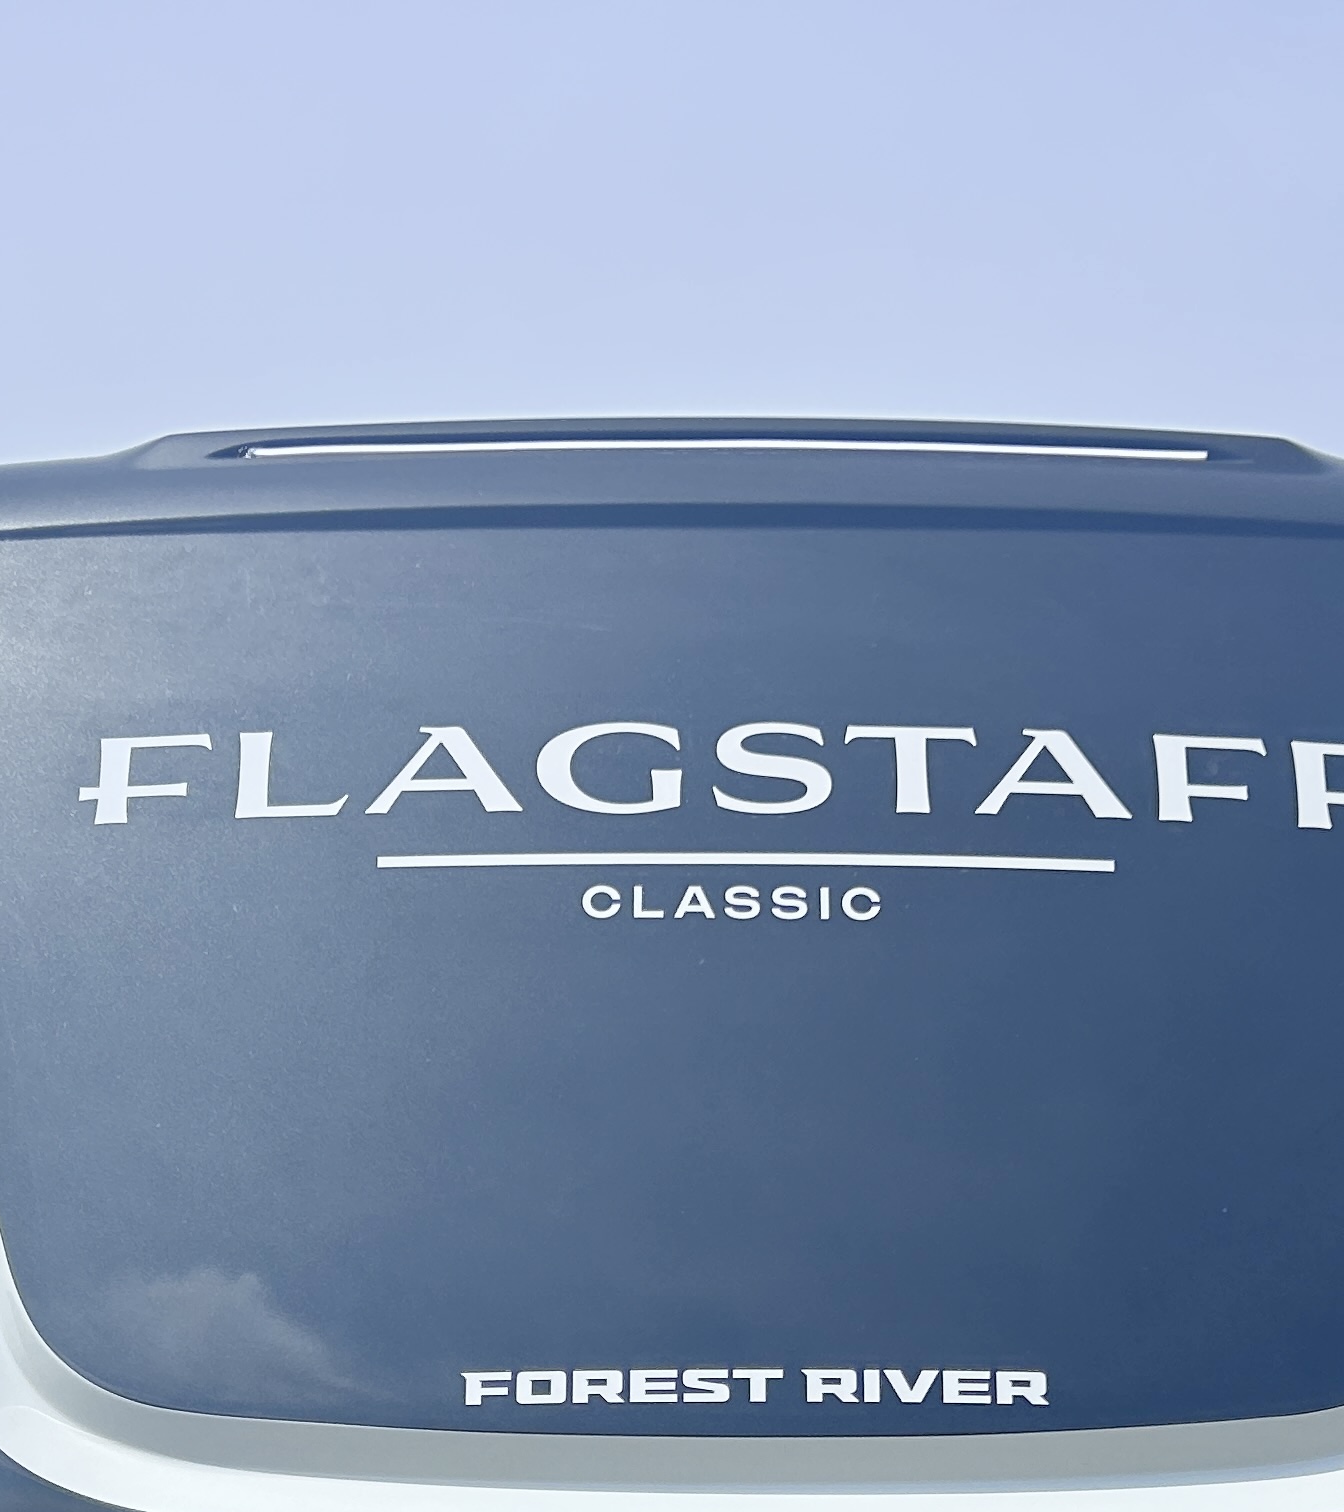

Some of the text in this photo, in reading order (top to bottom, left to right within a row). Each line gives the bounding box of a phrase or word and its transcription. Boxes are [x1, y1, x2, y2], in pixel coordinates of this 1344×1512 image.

[582, 884, 882, 921] CLASSIC
[461, 1368, 1049, 1406] FOREST RIVER
